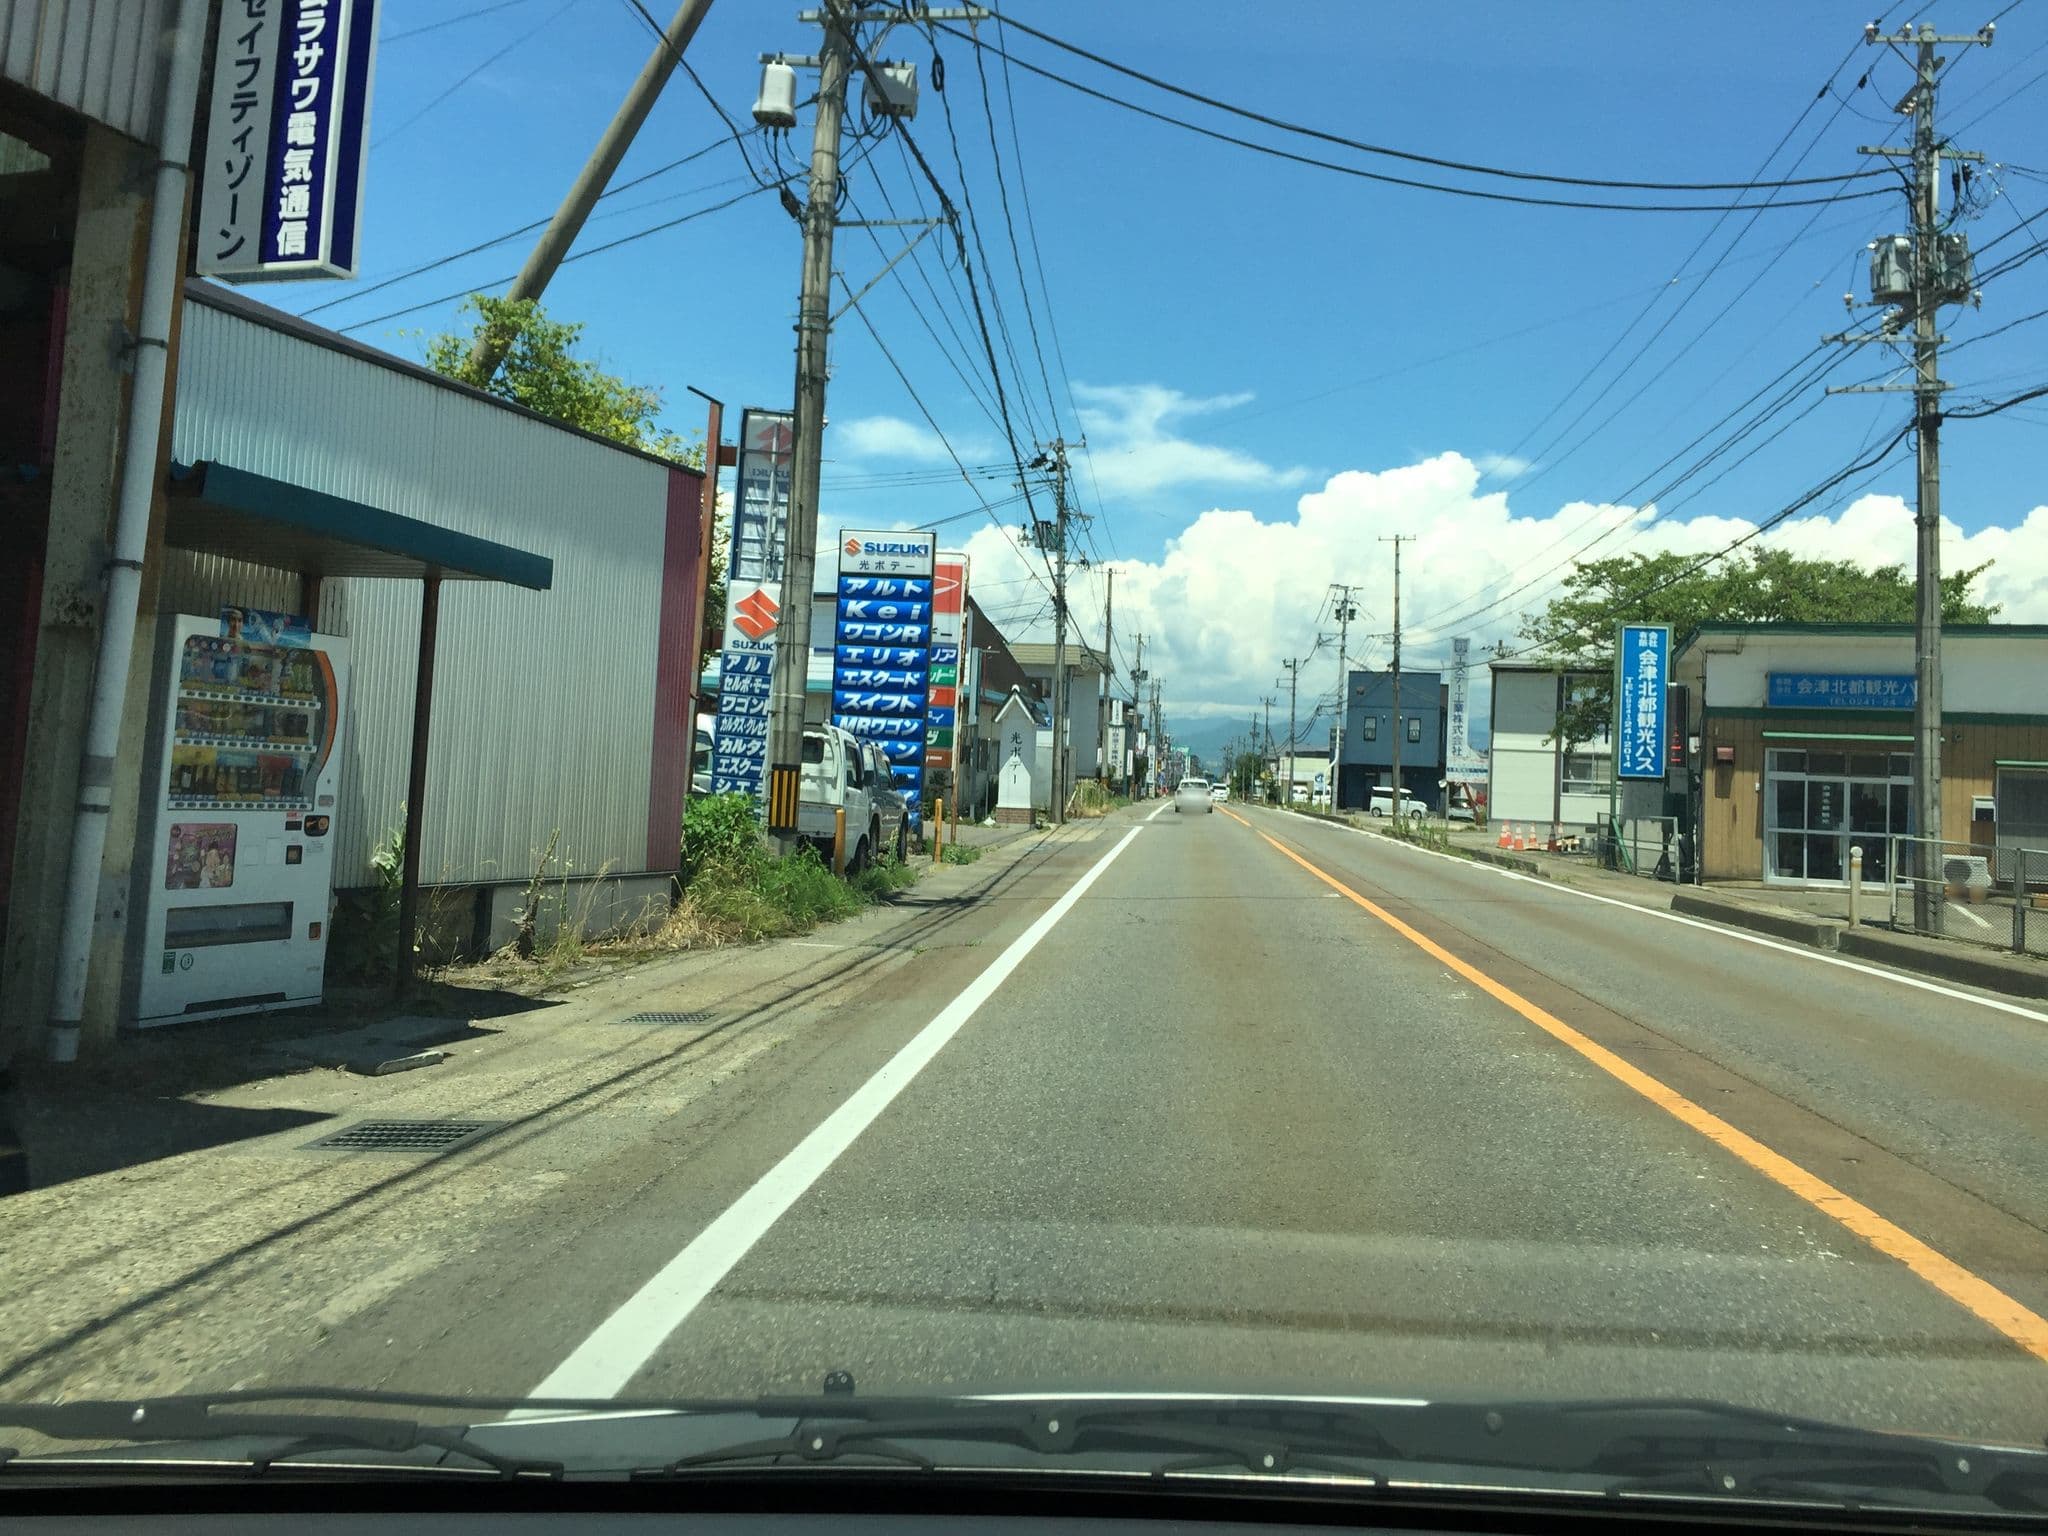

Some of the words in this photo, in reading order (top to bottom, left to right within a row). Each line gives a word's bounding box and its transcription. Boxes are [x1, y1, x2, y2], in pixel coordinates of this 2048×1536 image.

[864, 542, 929, 558] SUZUKI
[859, 560, 916, 571] 光ボデー
[846, 579, 923, 597] アルト
[846, 601, 922, 620] Kei
[844, 623, 922, 642] ワゴンR
[732, 640, 774, 651] SUZUK
[843, 648, 920, 666] エリオ
[723, 675, 770, 693] セルボ・モー
[841, 670, 921, 688] エスクード
[1797, 678, 1918, 696] 会津北都観光バ
[841, 693, 917, 712] スイフト
[1635, 649, 1659, 772] 会津北都観光バス
[839, 717, 919, 736] MRワゴン
[716, 757, 764, 778] エスクー
